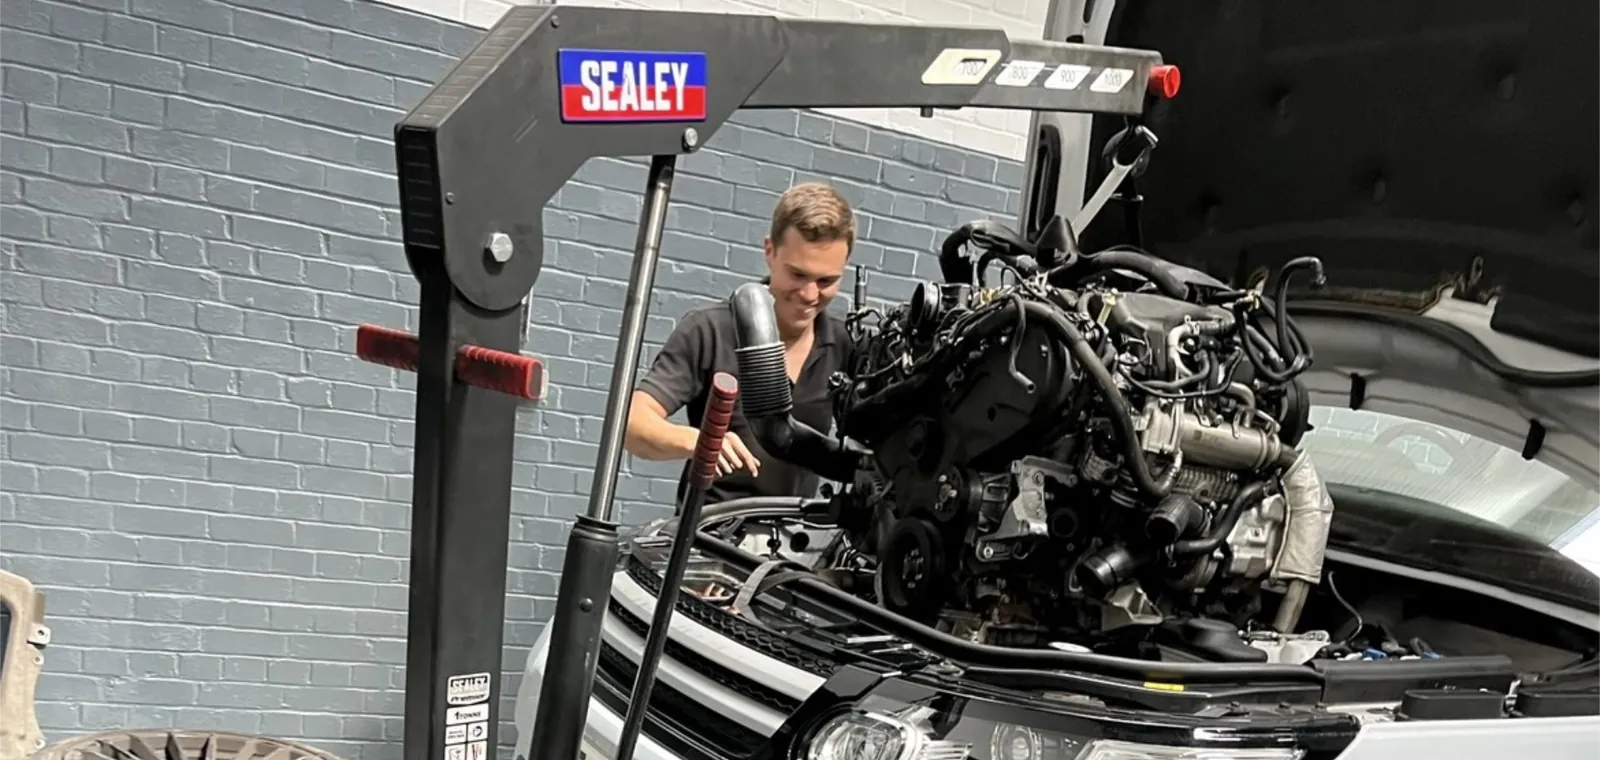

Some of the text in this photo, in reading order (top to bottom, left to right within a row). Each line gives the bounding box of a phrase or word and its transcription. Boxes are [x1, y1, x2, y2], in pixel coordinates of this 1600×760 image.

[1011, 64, 1029, 80] 800
[1060, 68, 1077, 84] 900
[580, 59, 689, 112] SEALEY
[450, 677, 487, 693] SEALEY
